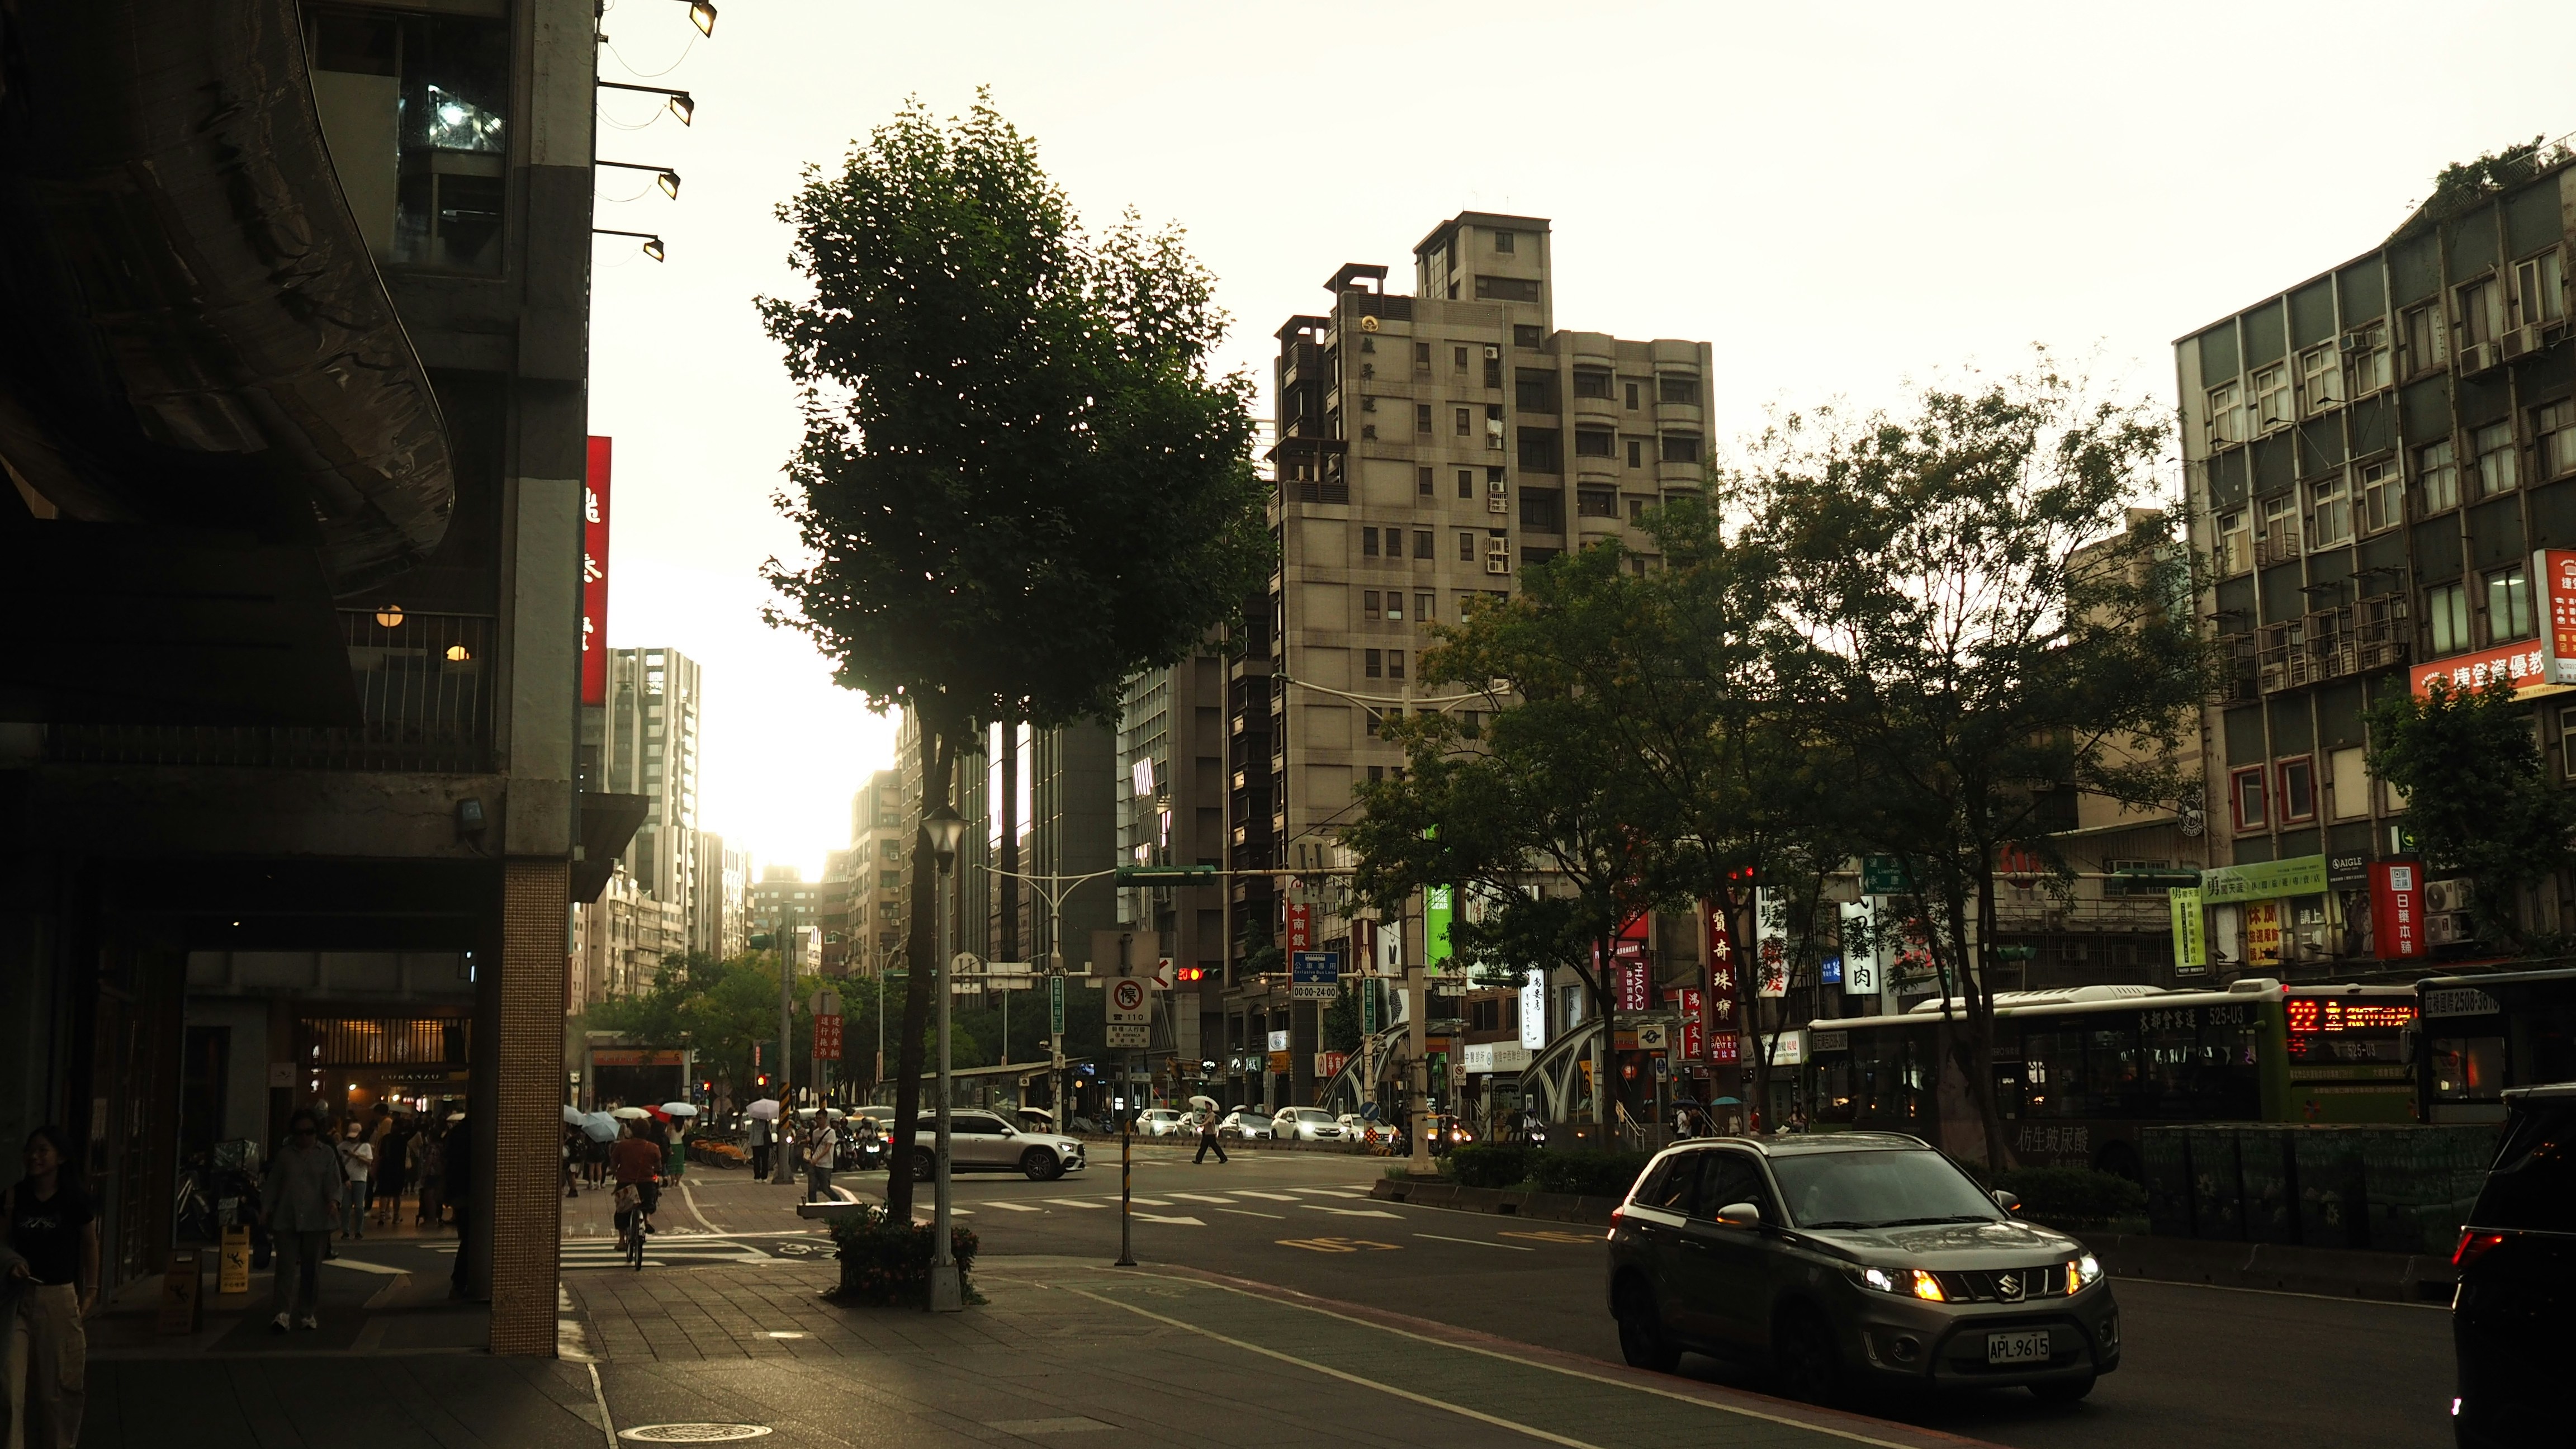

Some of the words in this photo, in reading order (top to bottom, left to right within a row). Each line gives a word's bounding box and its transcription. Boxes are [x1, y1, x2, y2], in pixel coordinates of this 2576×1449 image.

[2340, 857, 2362, 868] AIGLE
[1291, 903, 1306, 951] 華南銀
[2397, 894, 2412, 954] 日藥本舖
[1712, 909, 1733, 1021] 寶奇珠寶
[1120, 987, 1136, 1004] 停
[1295, 987, 1336, 997] 00:00~24:00
[2209, 1005, 2243, 1026] 525-U3
[2347, 1043, 2376, 1057] 525-U3
[693, 1083, 700, 1093] P
[2015, 1125, 2091, 1158] 仿生玻尿酸
[1990, 1337, 2048, 1360] APL-9615
